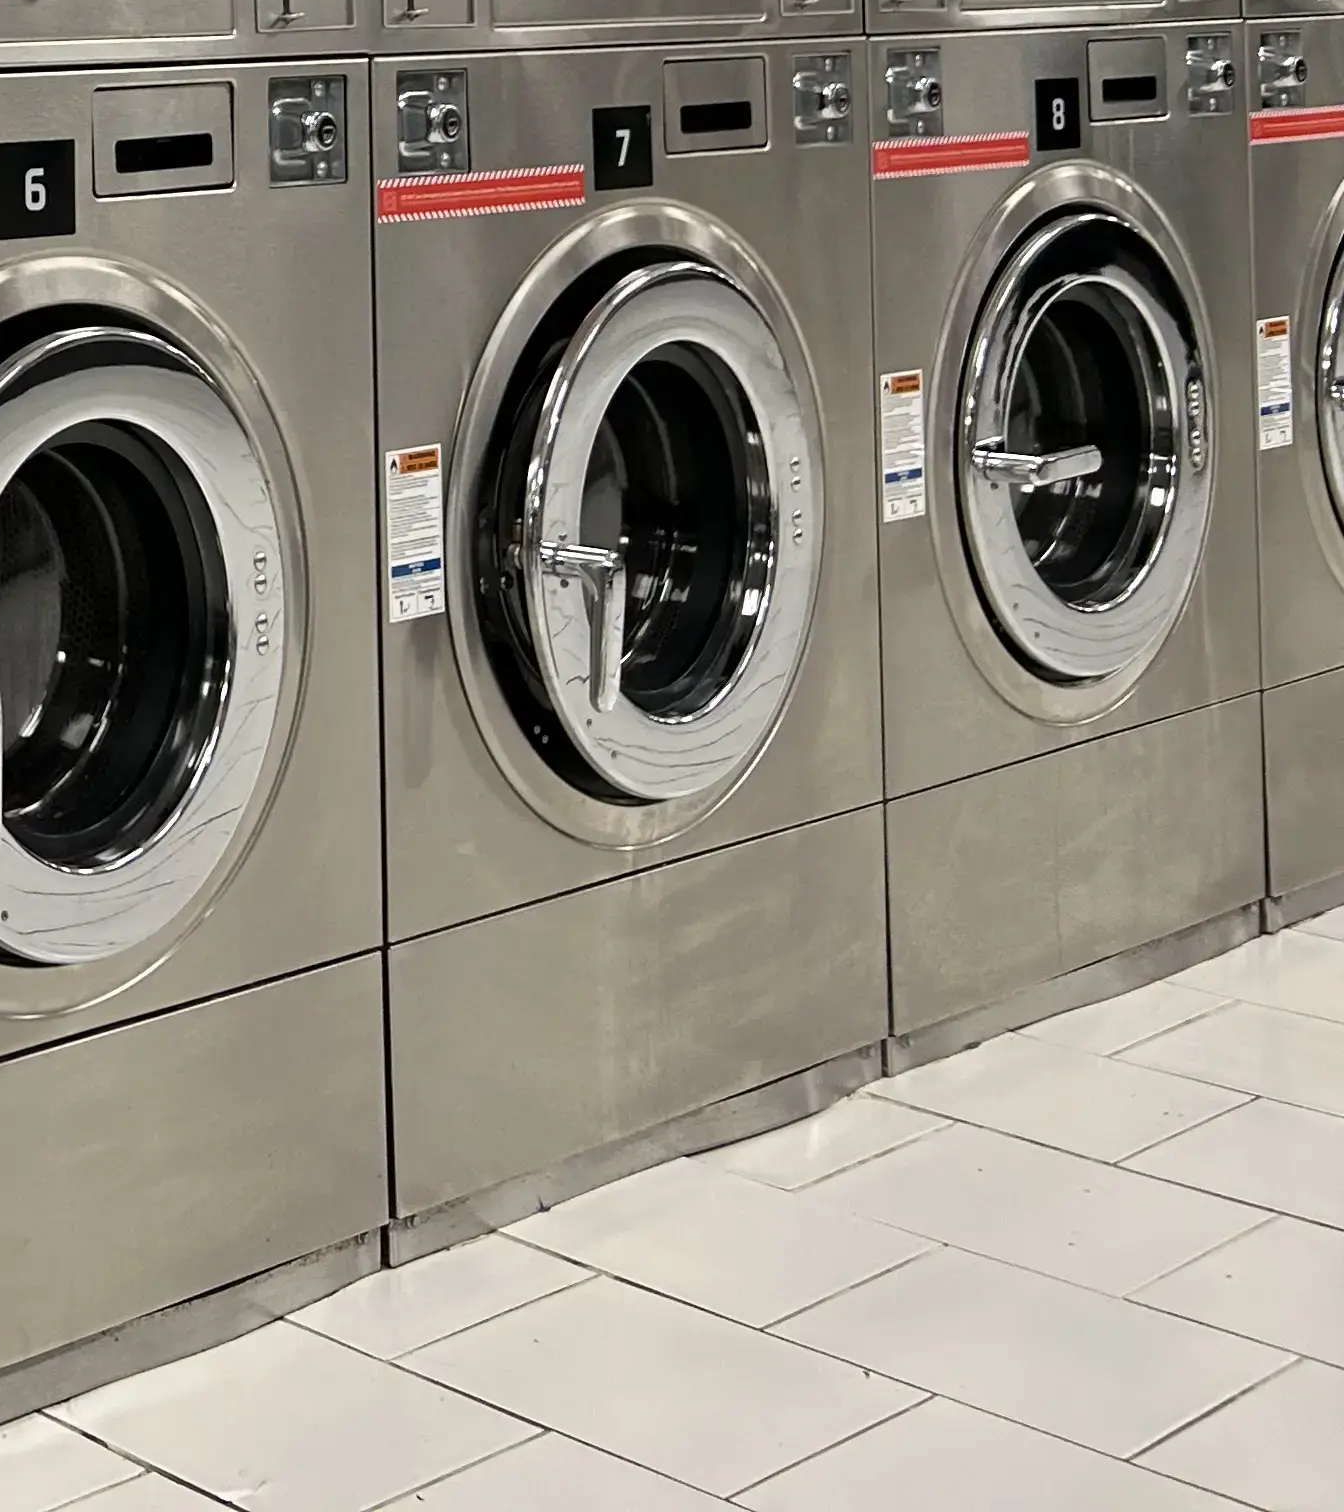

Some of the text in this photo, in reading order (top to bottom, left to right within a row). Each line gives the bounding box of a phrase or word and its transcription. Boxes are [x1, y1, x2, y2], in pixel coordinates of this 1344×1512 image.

[1052, 97, 1066, 130] 8
[615, 129, 631, 167] 7
[24, 167, 47, 212] 6
